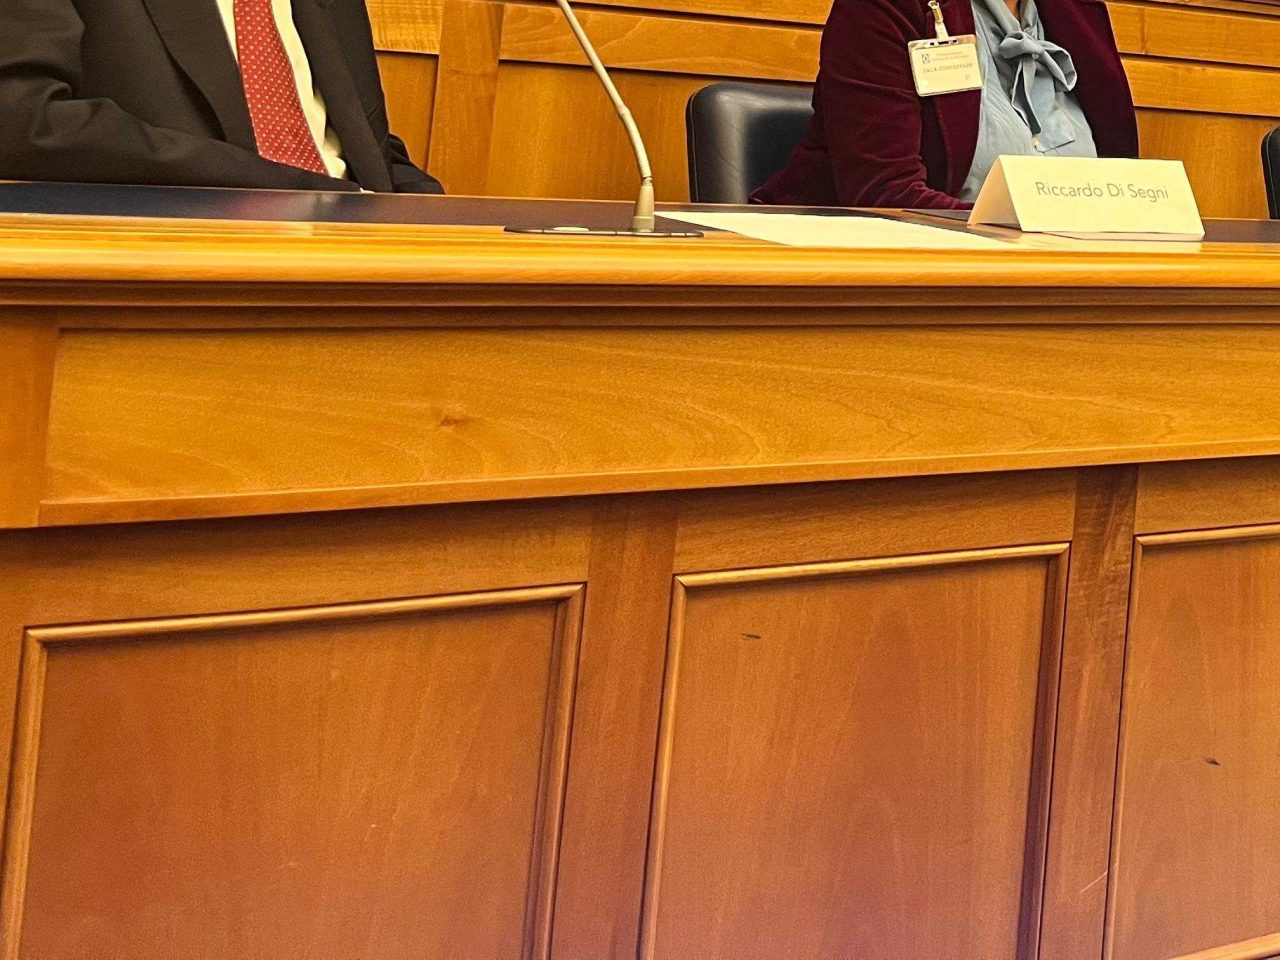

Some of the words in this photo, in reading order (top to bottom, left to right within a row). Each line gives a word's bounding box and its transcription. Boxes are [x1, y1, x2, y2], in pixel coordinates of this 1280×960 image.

[1035, 181, 1103, 198] Riccardo
[1106, 183, 1125, 198] Di
[1128, 183, 1169, 203] Segni
